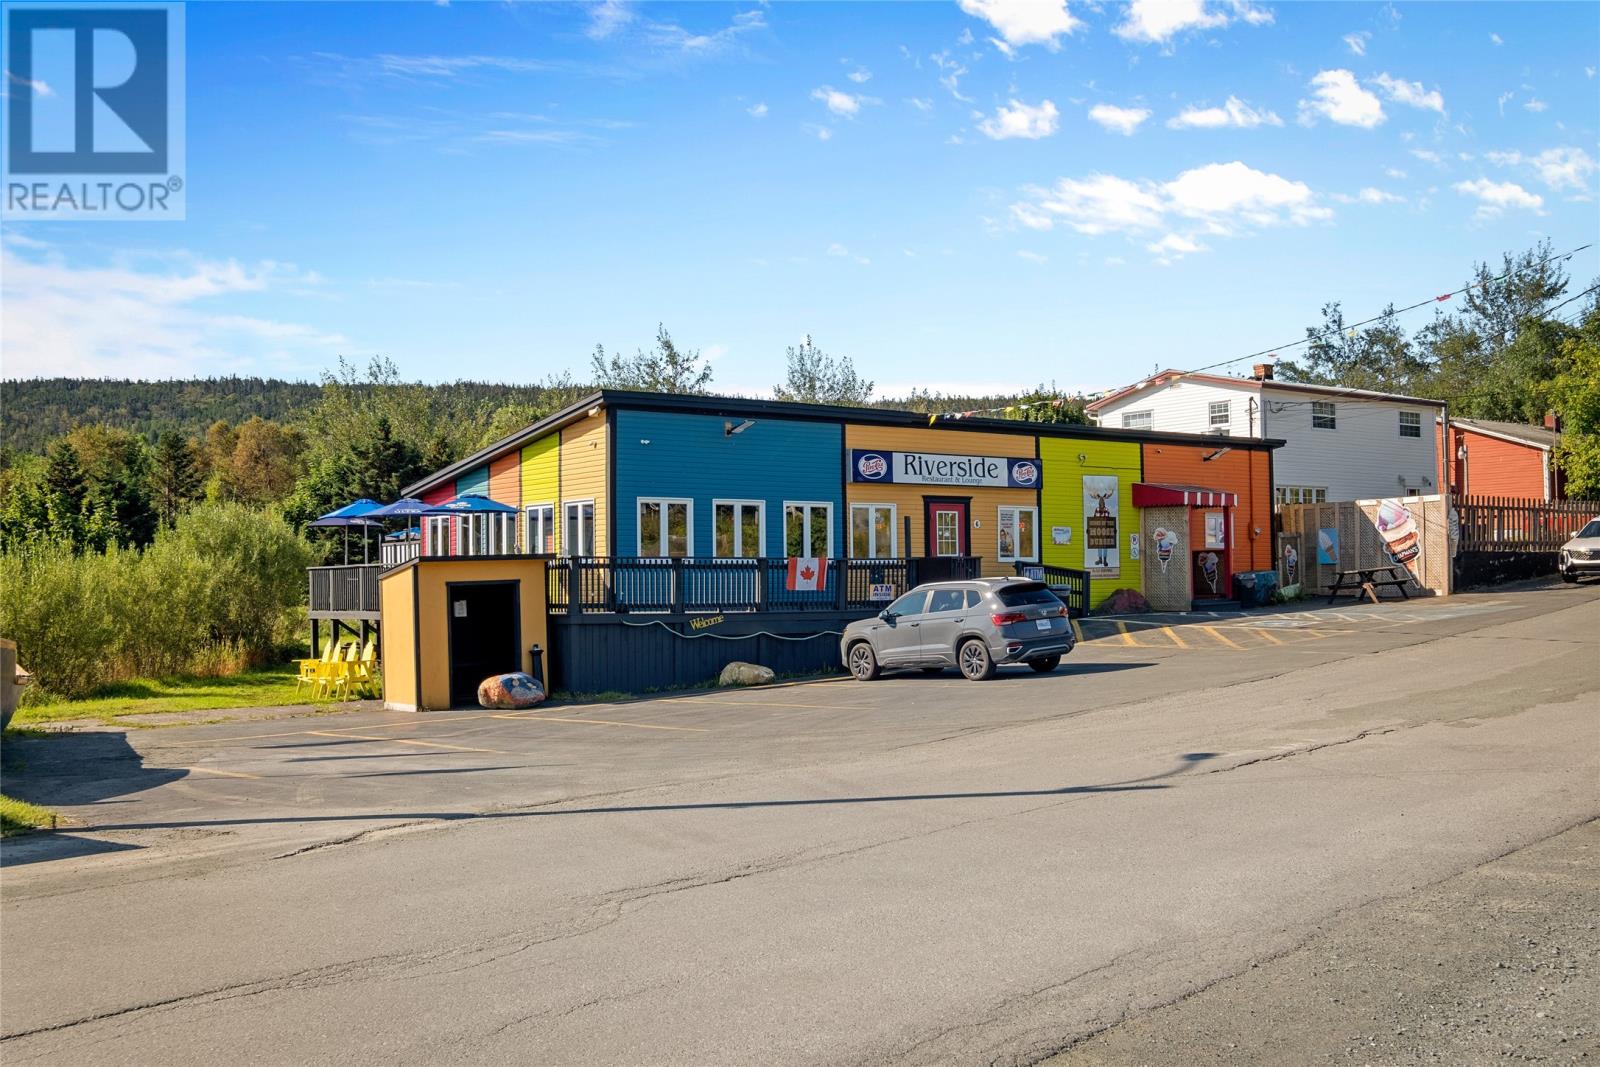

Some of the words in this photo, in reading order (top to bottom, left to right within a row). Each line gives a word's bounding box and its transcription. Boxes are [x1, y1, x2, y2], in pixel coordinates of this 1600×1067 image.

[904, 454, 999, 479] Riverside
[921, 475, 953, 483] Restaurant
[962, 477, 983, 486] Lounge
[873, 585, 892, 593] ATM
[689, 614, 725, 631] Welcome
